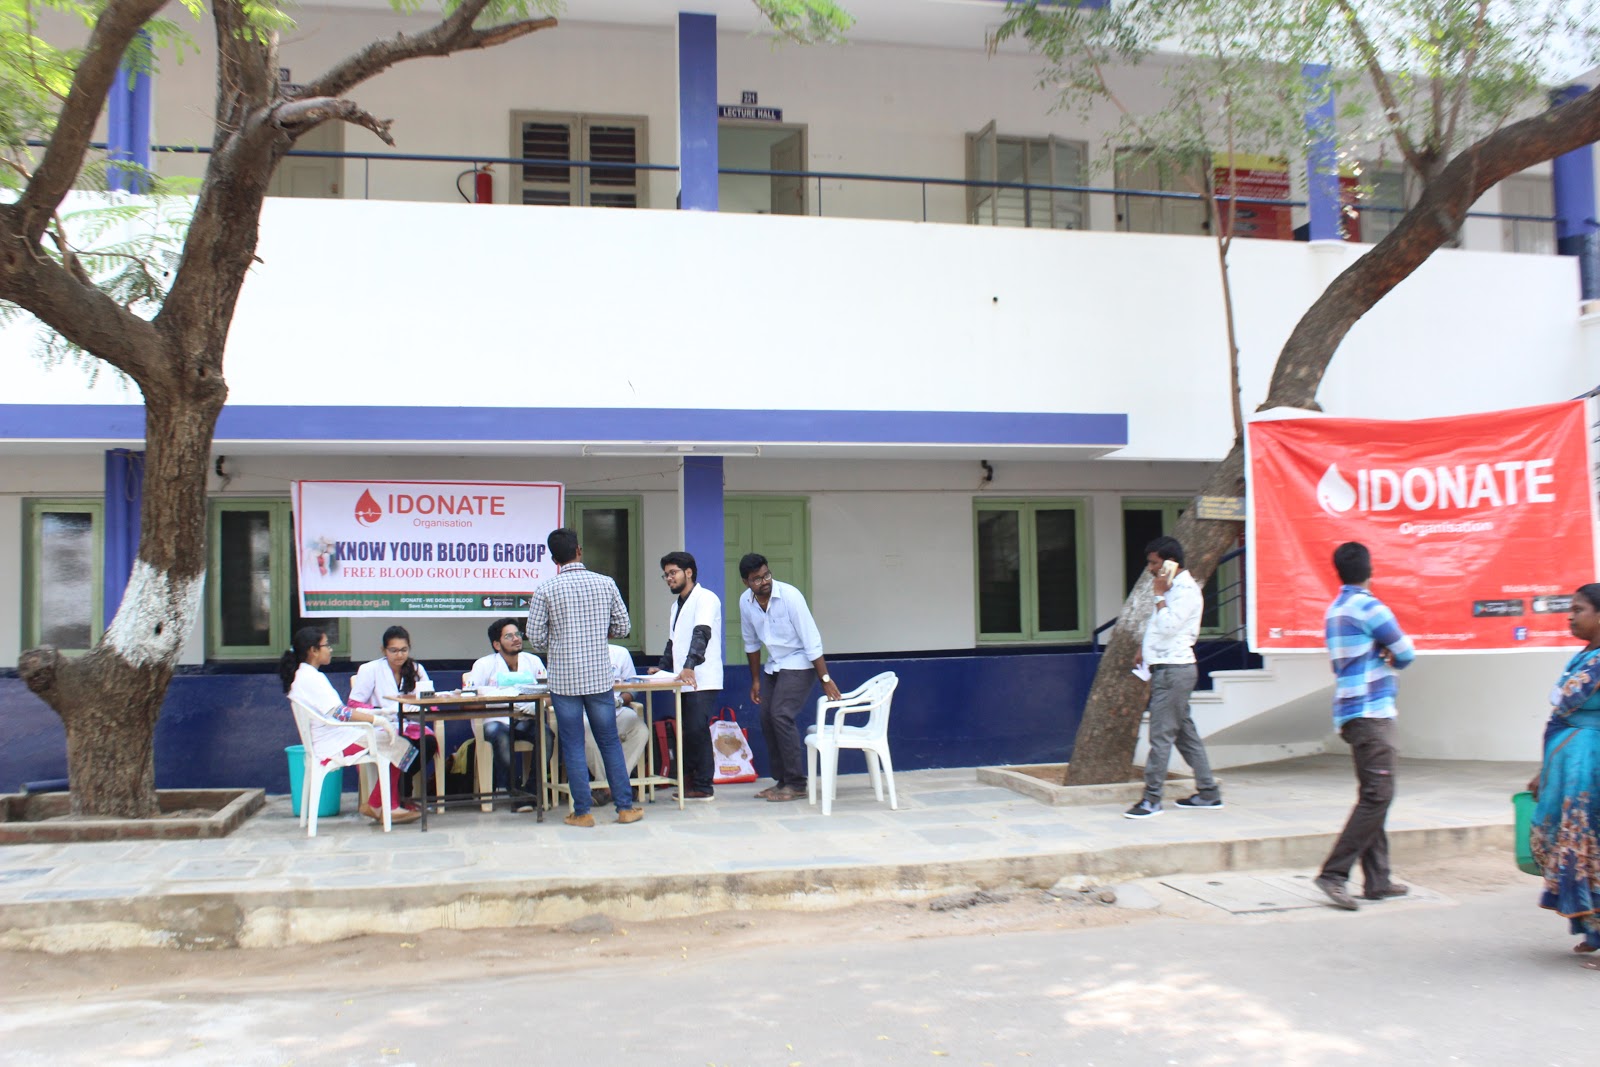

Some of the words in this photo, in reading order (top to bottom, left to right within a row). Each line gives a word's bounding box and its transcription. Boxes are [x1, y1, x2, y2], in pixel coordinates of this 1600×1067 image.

[723, 107, 756, 118] LECTURE
[757, 108, 776, 119] HALL
[1357, 457, 1556, 513] IDONATE
[388, 494, 505, 515] IDONATE
[413, 518, 472, 528] Organisation
[1399, 520, 1494, 537] Organisation
[335, 541, 387, 561] KNOW
[389, 542, 433, 562] YOUR
[437, 542, 489, 562] BLOOD
[493, 543, 546, 563] GROUP
[343, 567, 376, 578] FREE
[379, 567, 424, 578] BLOOD
[427, 567, 471, 579] GROUP
[473, 568, 539, 579] CHECKING
[306, 598, 389, 608] www.idonate.org.in
